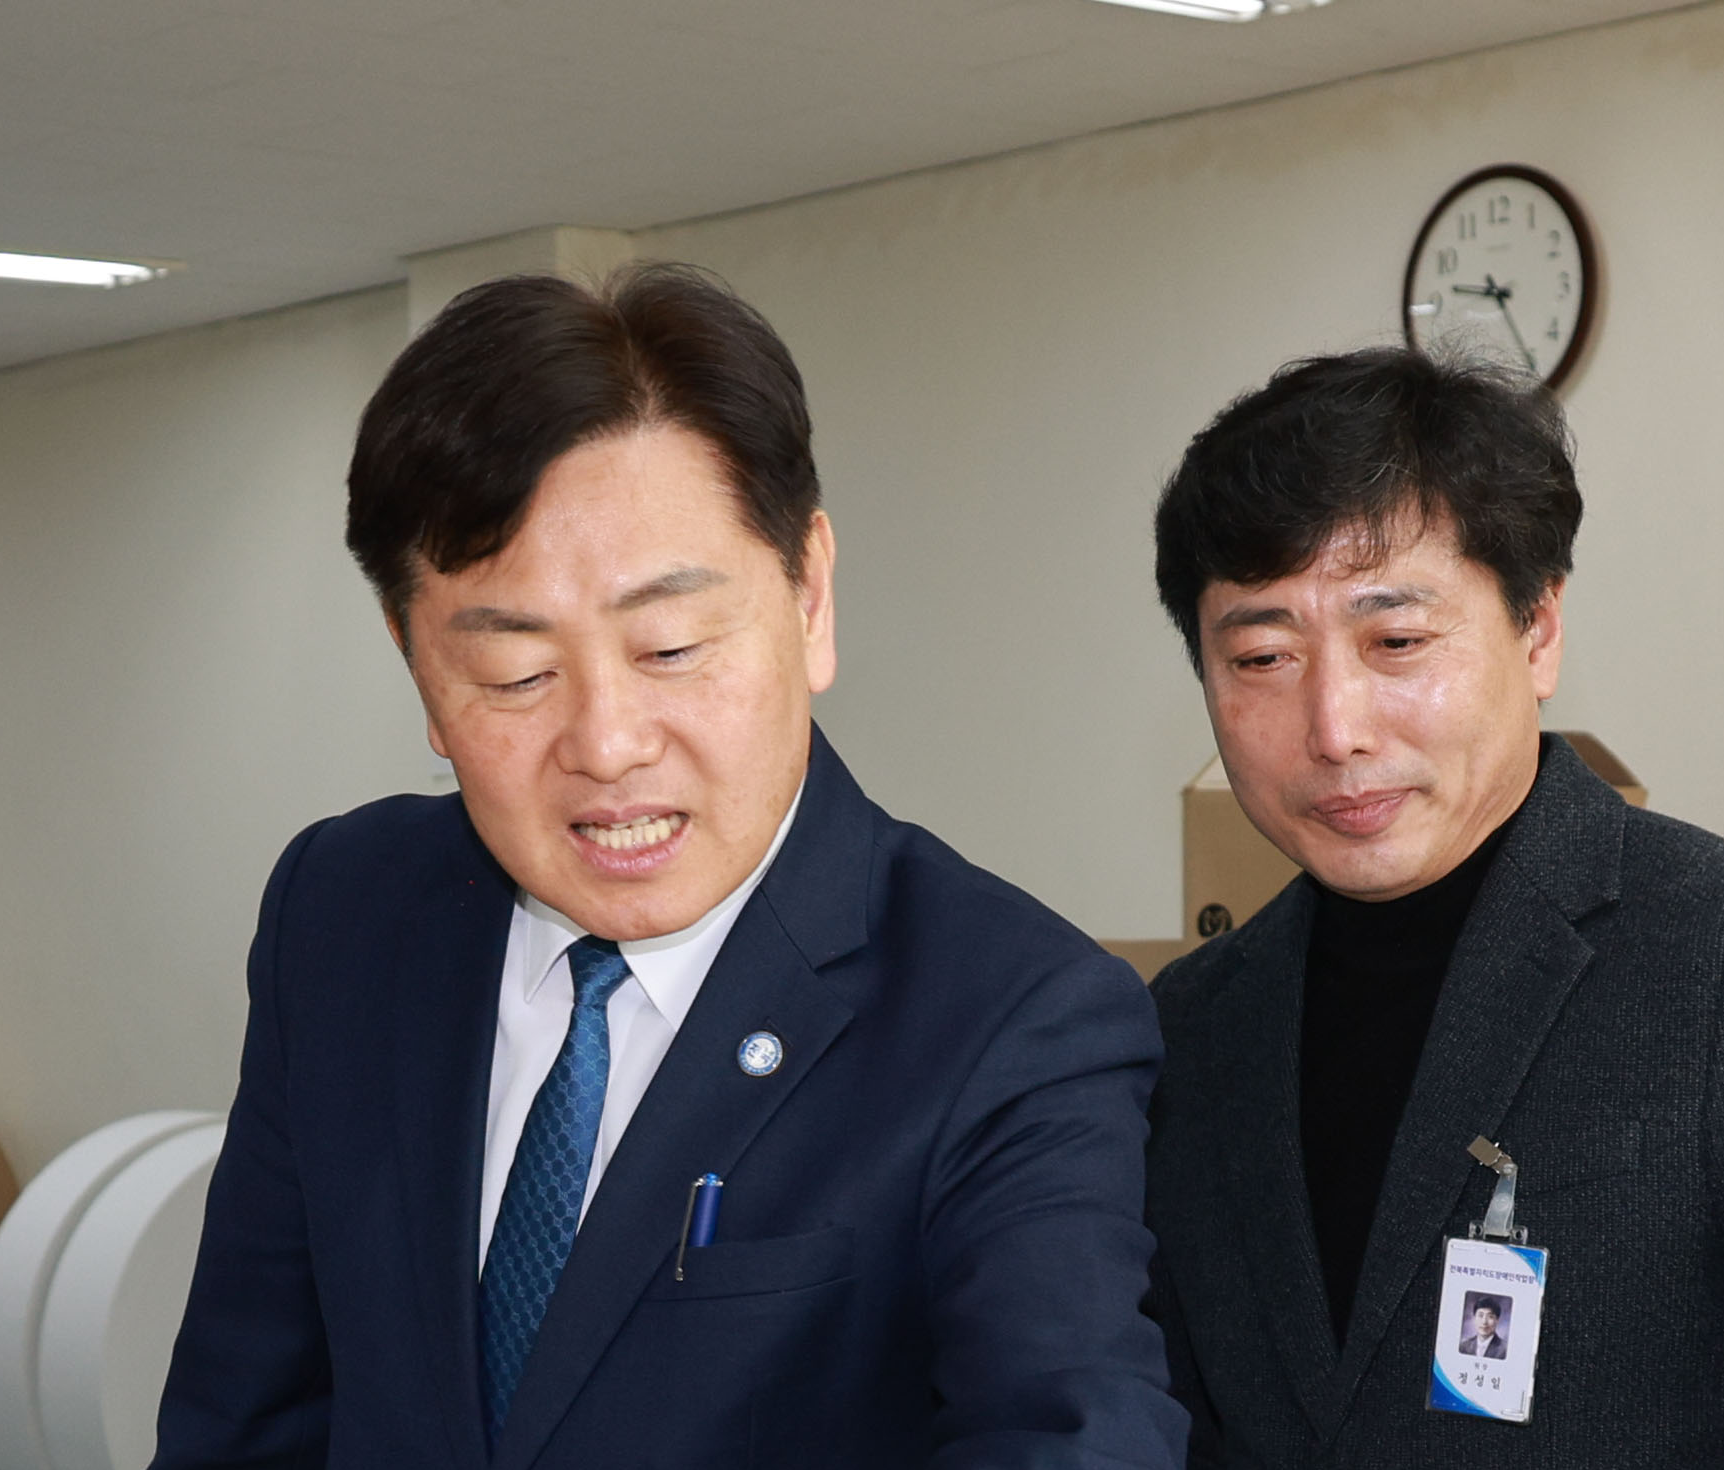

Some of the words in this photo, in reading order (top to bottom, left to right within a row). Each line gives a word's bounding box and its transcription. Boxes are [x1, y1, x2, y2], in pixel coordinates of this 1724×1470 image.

[1487, 195, 1510, 224] 12
[1528, 202, 1536, 230] 1
[1459, 212, 1477, 240] 11
[1547, 229, 1561, 258] 2
[1438, 247, 1458, 275] 10
[1559, 270, 1571, 299] 3
[1546, 316, 1559, 343] 4
